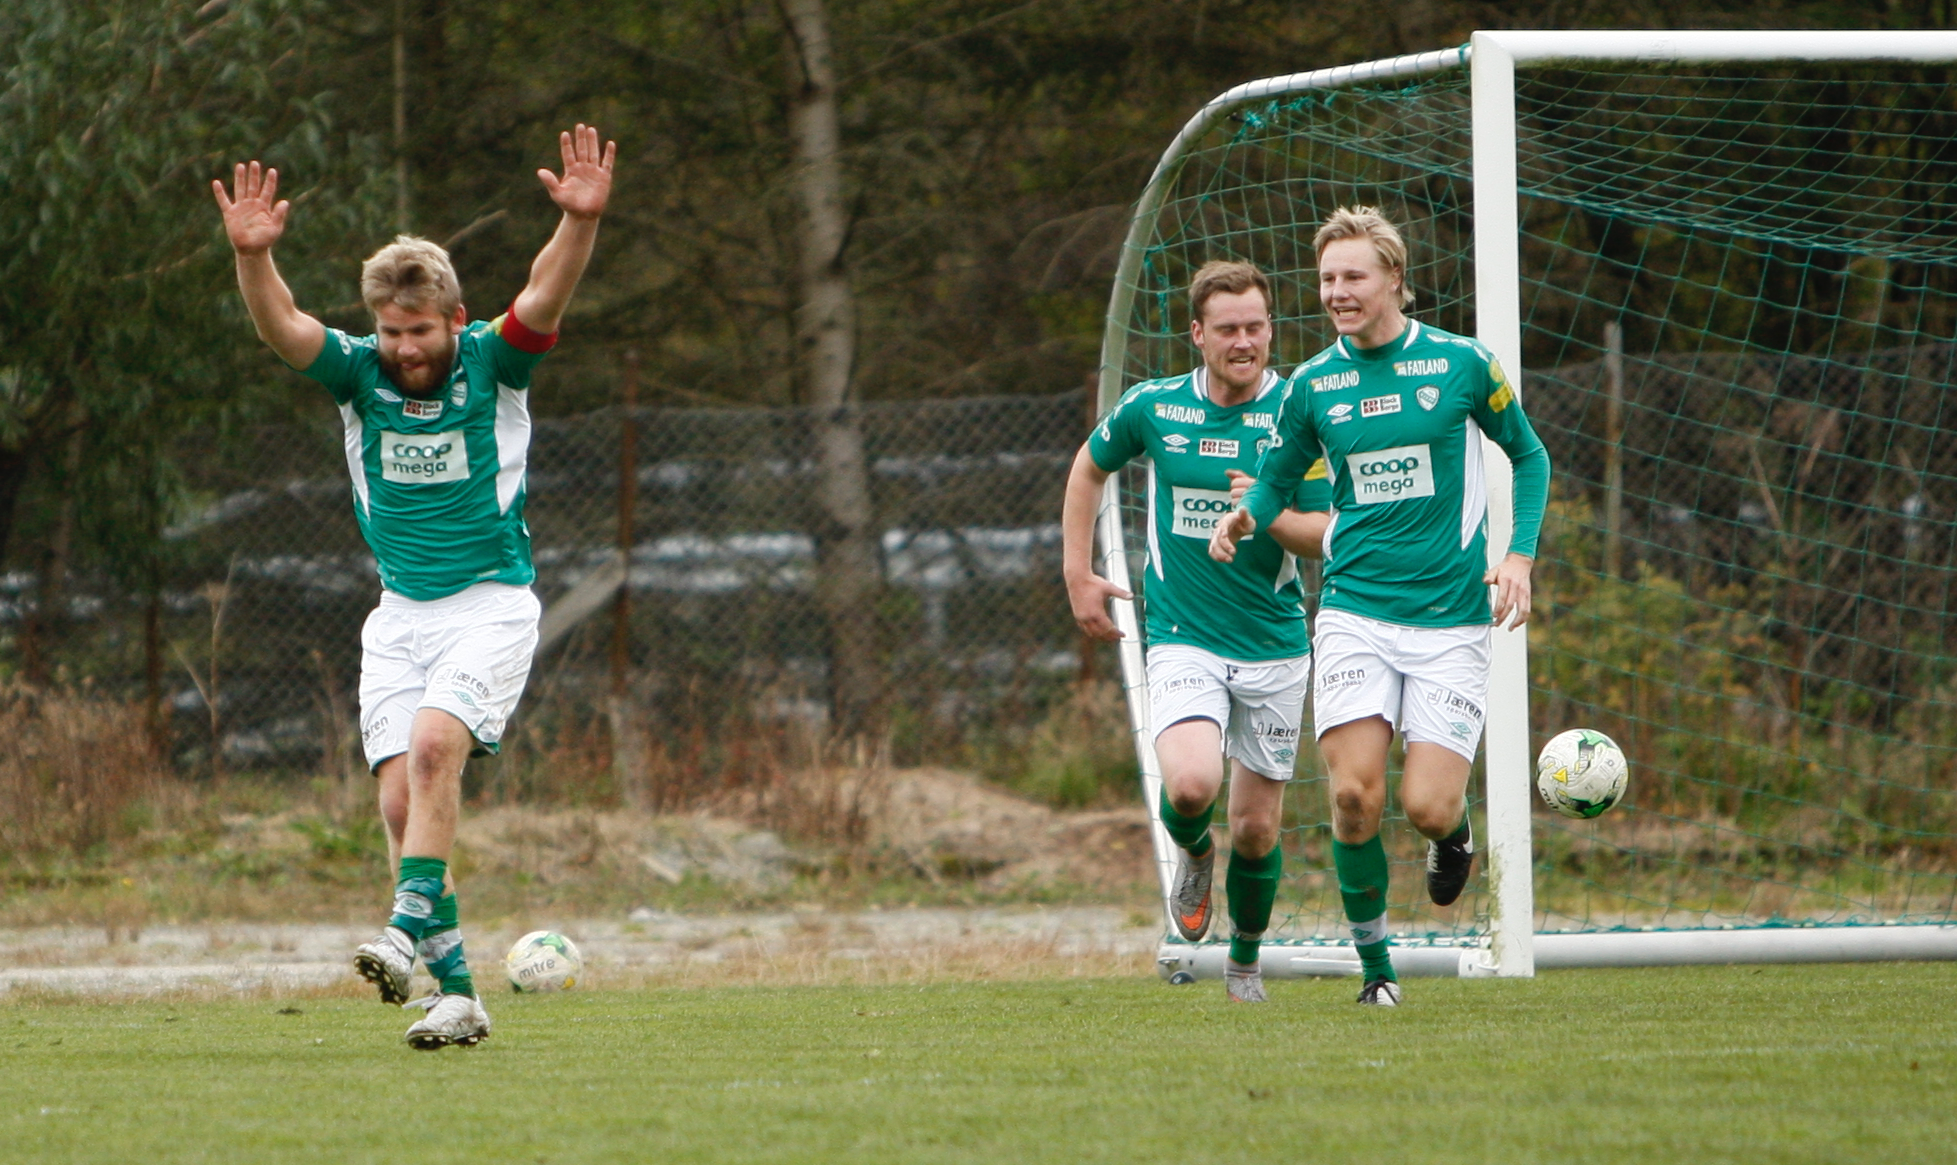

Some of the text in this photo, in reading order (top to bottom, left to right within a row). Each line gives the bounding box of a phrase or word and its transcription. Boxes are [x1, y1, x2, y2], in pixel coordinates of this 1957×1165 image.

[1407, 358, 1449, 376] FATLAND
[1322, 370, 1360, 392] FATLAND
[1165, 404, 1206, 425] FATLAND
[1254, 412, 1275, 429] FATL
[392, 442, 453, 460] coop
[392, 461, 448, 477] mega
[1359, 456, 1420, 477] coop
[1363, 477, 1415, 495] mega
[1266, 722, 1299, 738] jære
[518, 958, 556, 981] mitre
